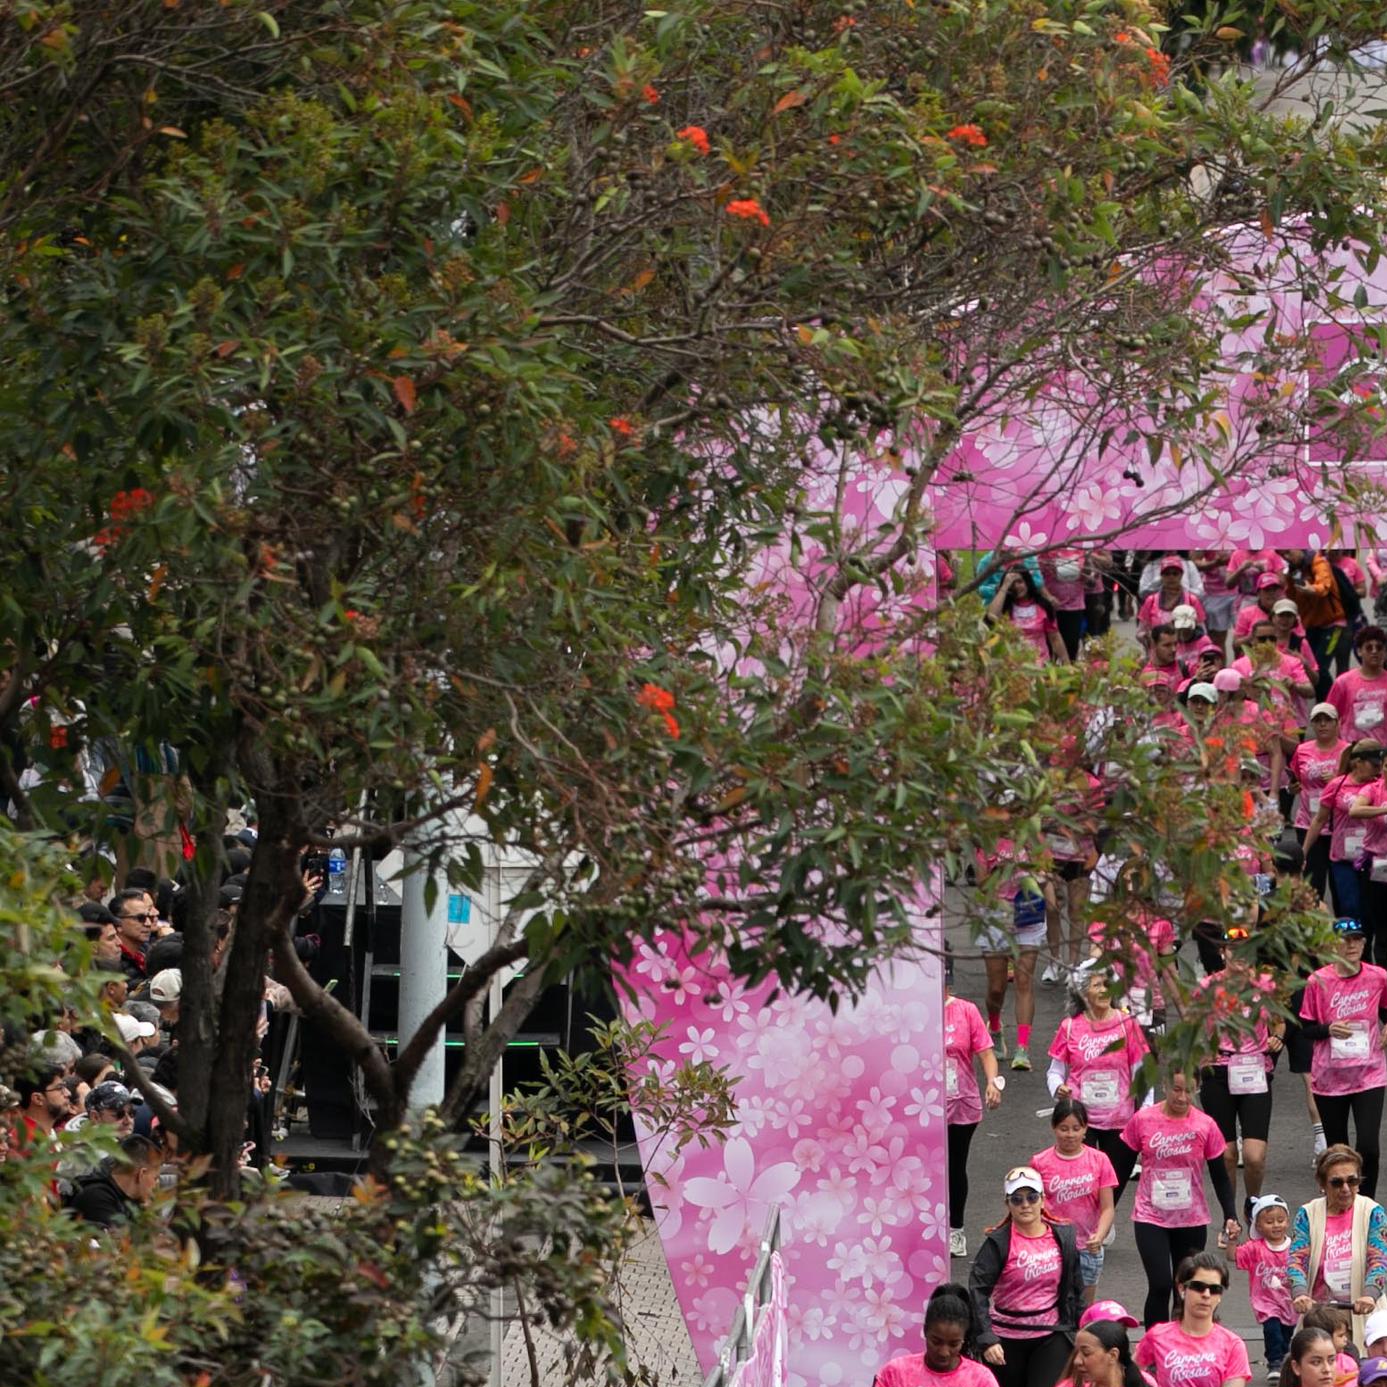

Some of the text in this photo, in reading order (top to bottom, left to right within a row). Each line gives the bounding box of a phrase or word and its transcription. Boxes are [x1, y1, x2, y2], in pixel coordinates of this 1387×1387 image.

[1150, 1131, 1197, 1149] Carrera
[1156, 1144, 1193, 1160] Rosas
[1049, 1173, 1094, 1192] Carrera
[1057, 1187, 1092, 1203] Rosas
[1164, 1350, 1216, 1368] Carrera
[1170, 1366, 1211, 1383] Rosas
